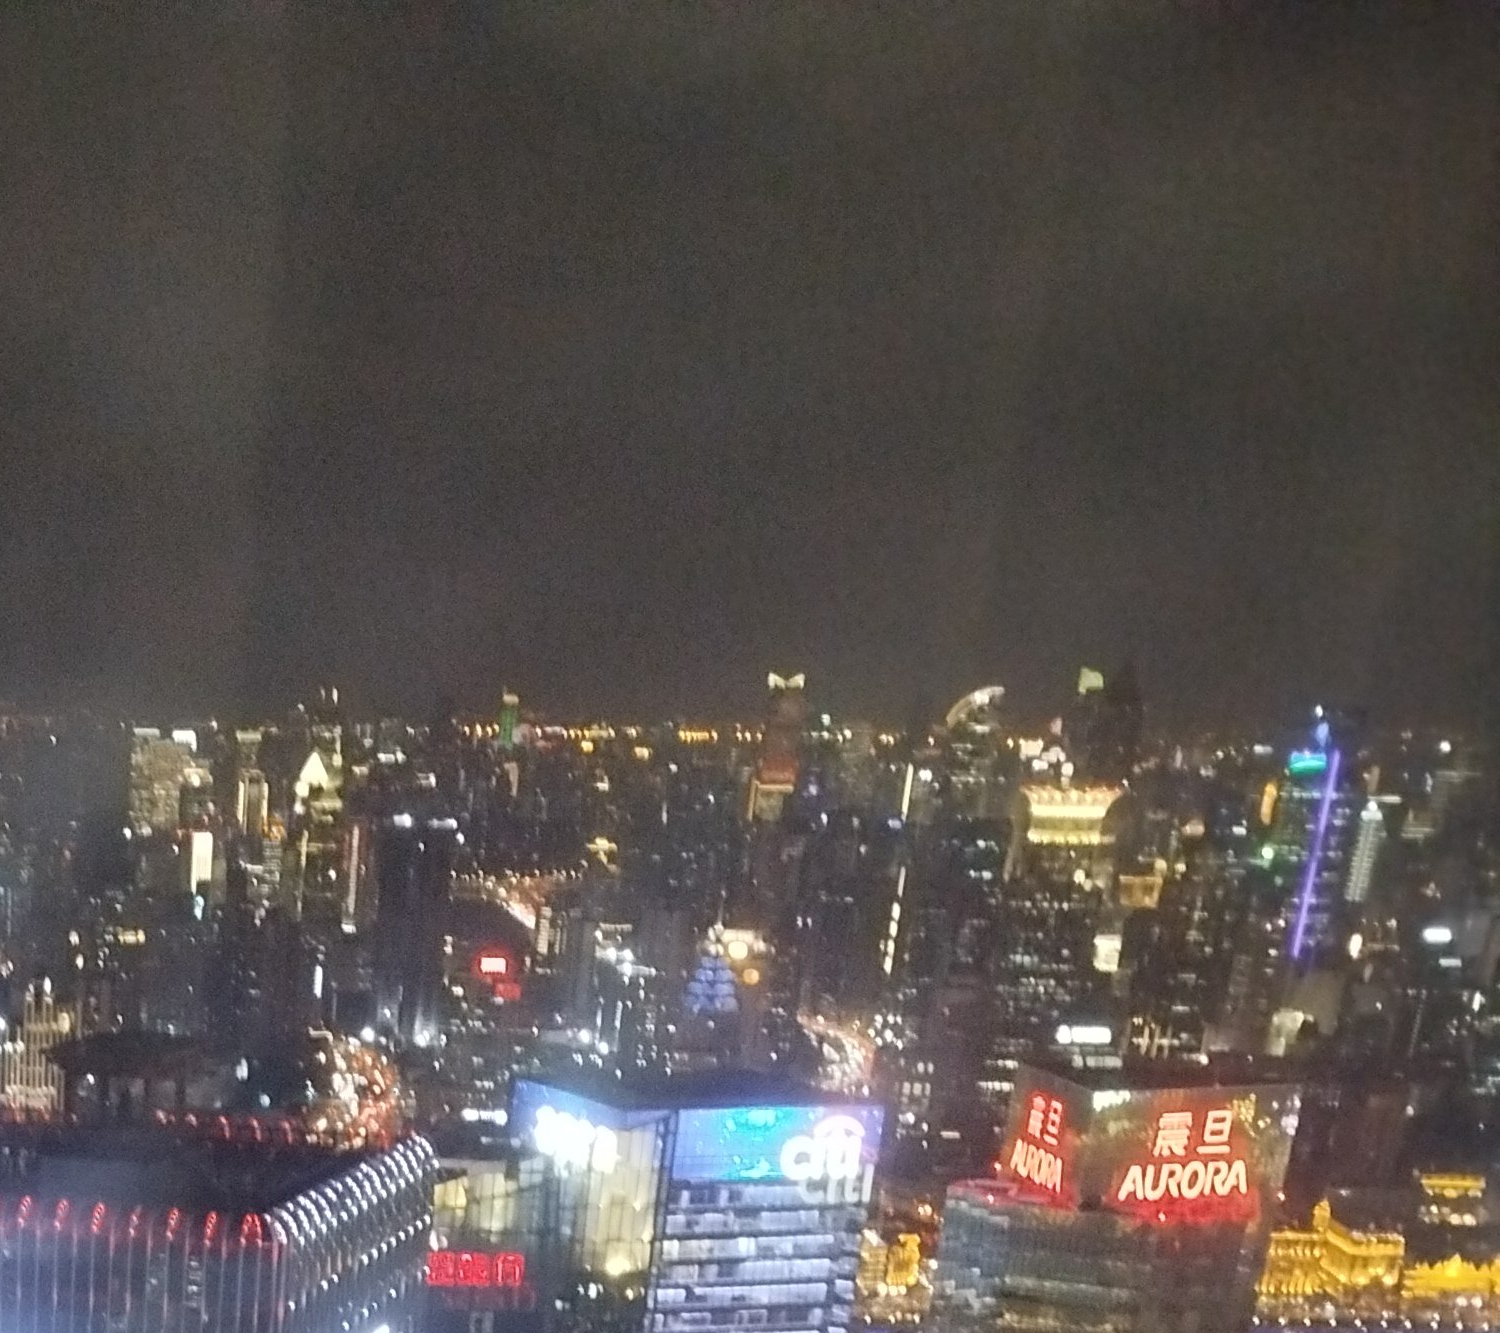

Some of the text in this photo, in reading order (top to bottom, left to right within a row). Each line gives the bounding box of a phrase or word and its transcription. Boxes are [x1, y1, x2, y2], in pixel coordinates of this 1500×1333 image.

[1152, 1110, 1233, 1157] 震旦
[1010, 1138, 1063, 1194] AURORA
[1117, 1159, 1248, 1201] AURORA
